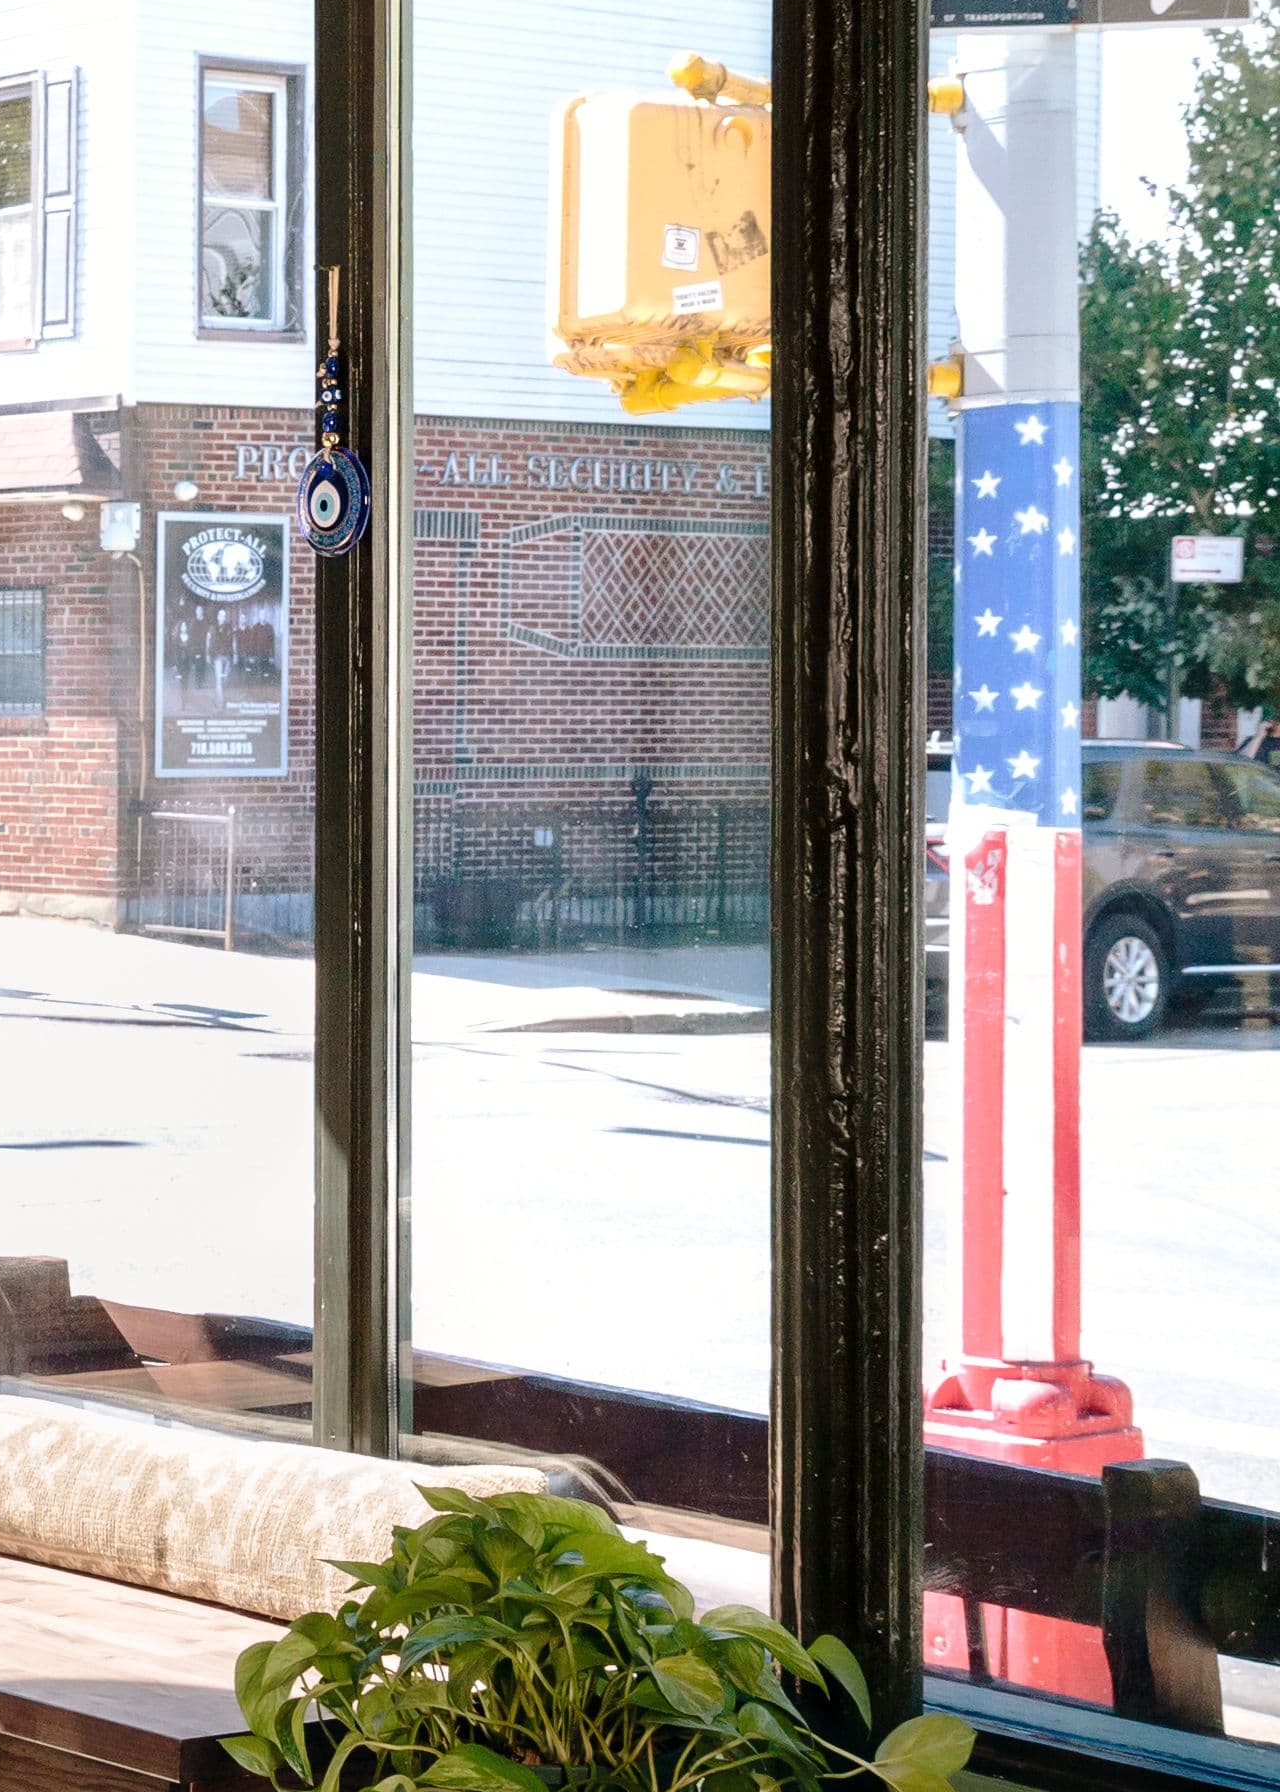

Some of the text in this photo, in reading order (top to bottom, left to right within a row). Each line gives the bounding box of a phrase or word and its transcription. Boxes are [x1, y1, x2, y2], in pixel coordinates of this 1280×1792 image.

[964, 12, 1045, 23] TRANSPORTATION
[527, 455, 697, 494] SECURITY
[716, 463, 740, 494] &
[181, 527, 268, 558] PROTECT-ALL
